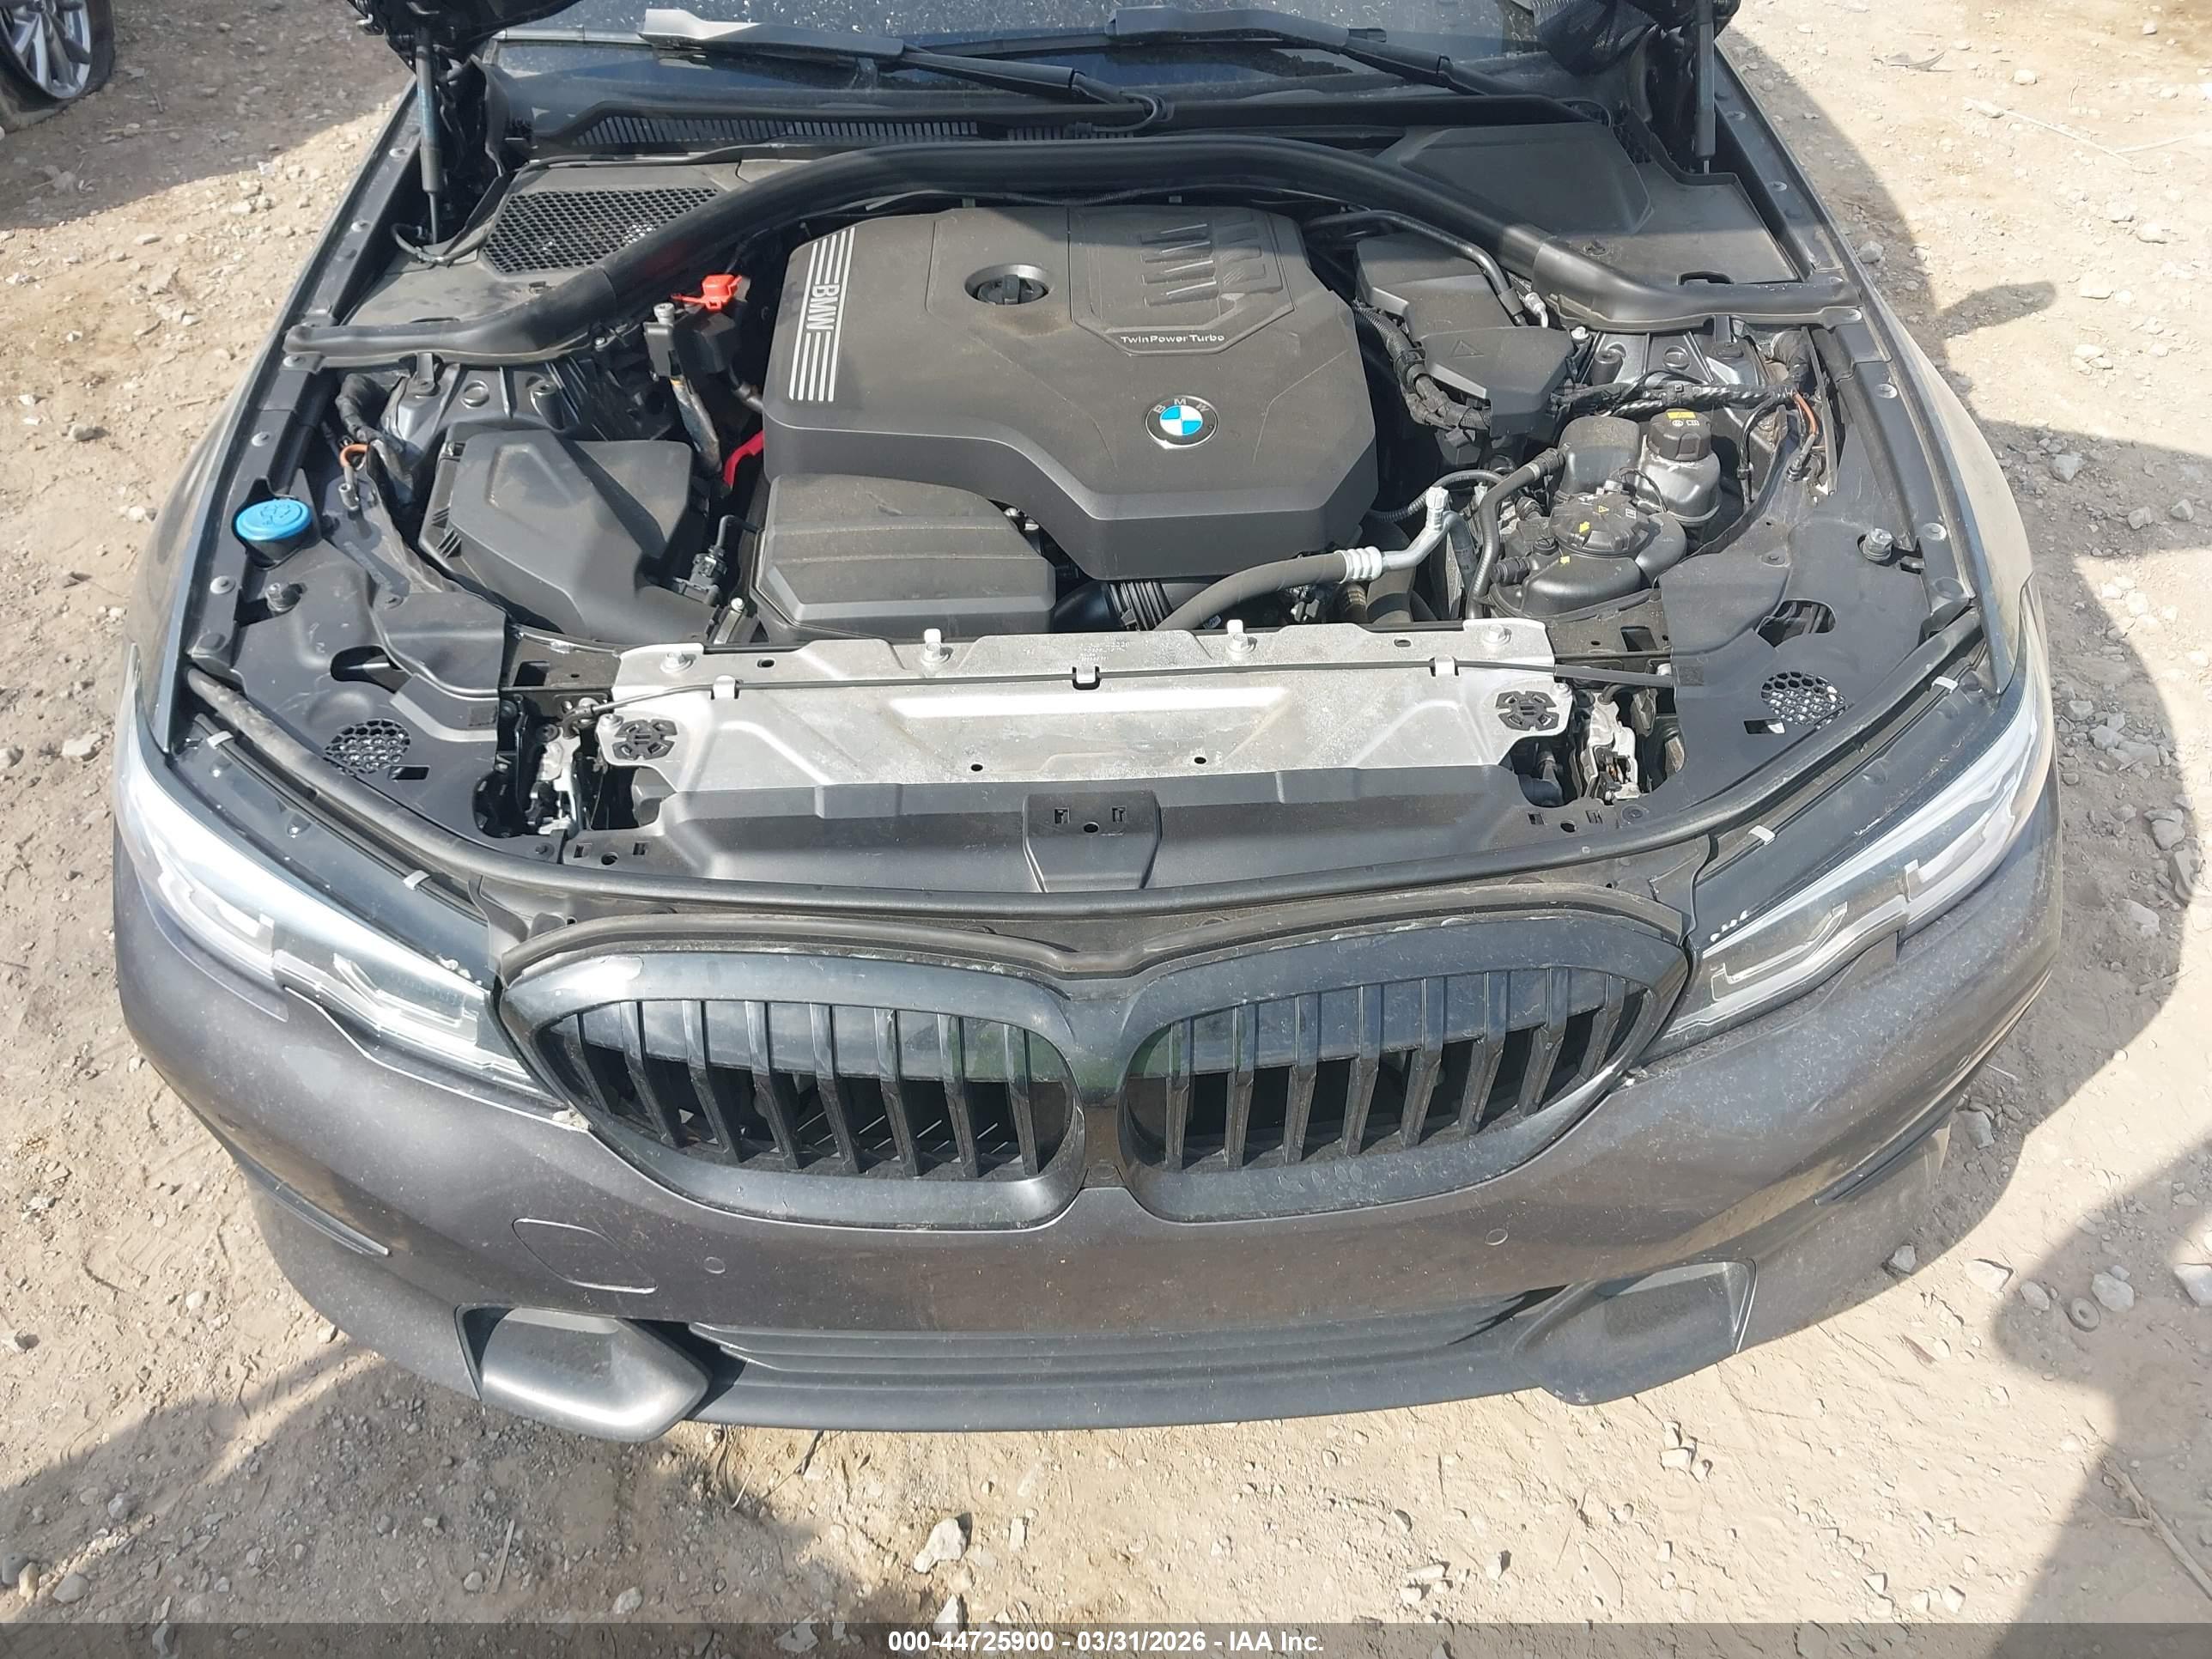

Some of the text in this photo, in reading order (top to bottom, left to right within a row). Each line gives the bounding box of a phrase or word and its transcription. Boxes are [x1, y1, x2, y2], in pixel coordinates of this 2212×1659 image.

[806, 284, 840, 330] BMW
[1120, 335, 1188, 343] TwinPower
[1152, 398, 1210, 414] BMW
